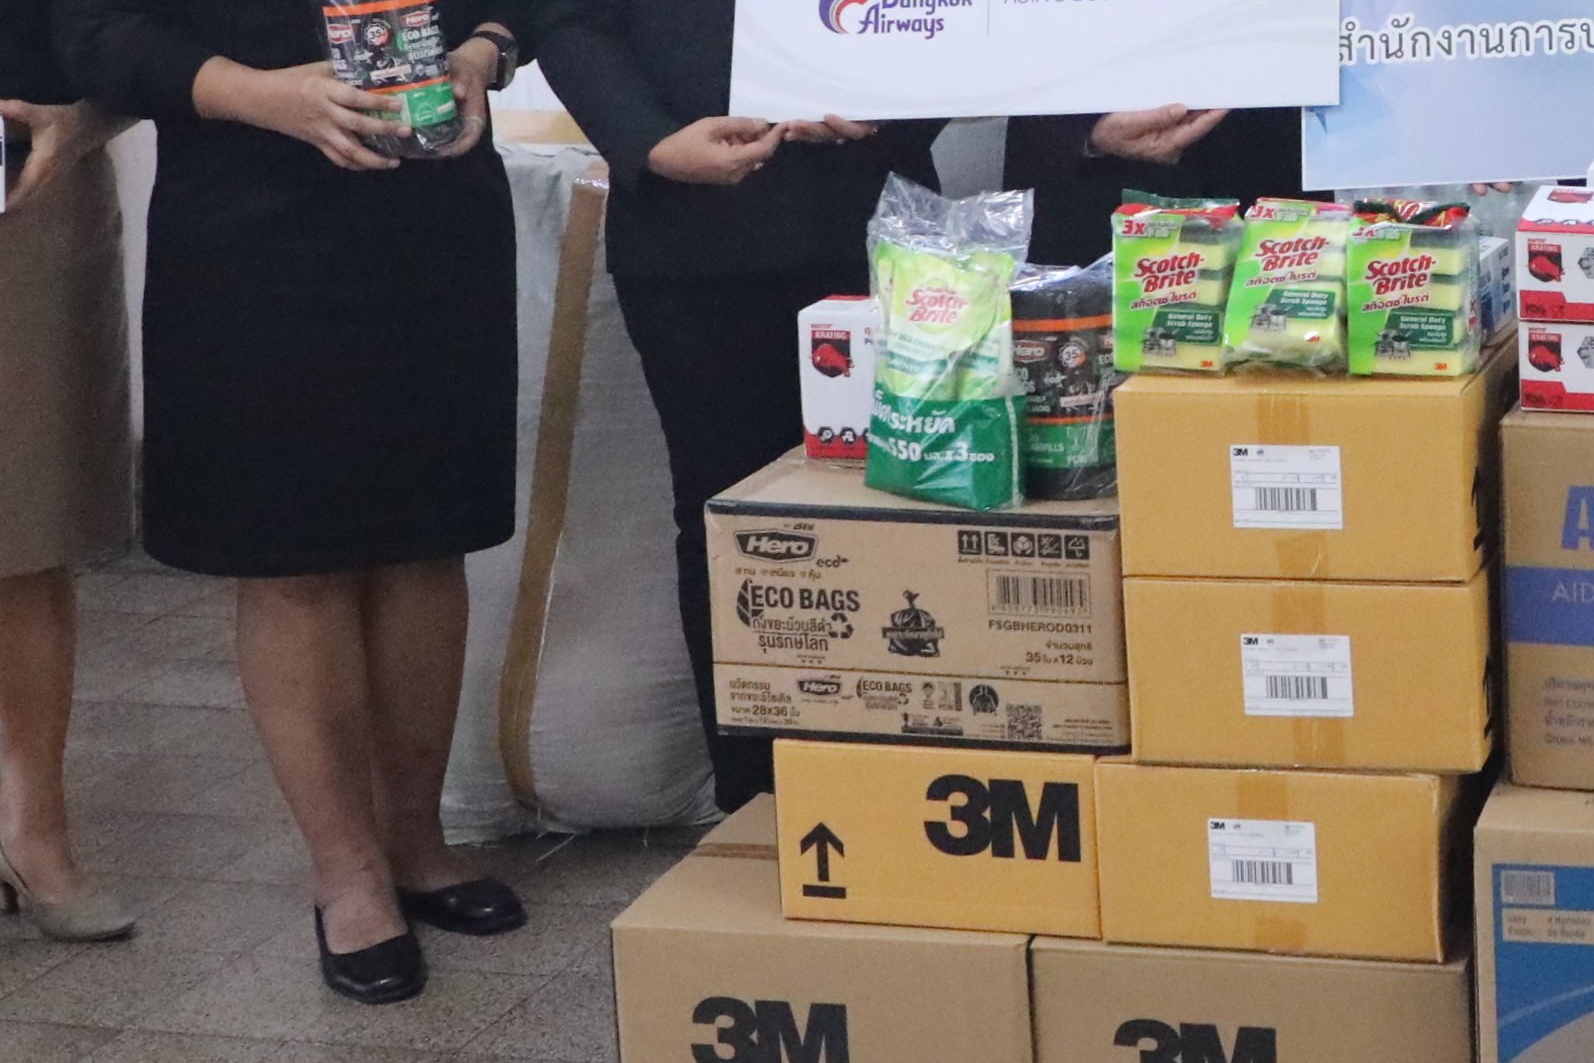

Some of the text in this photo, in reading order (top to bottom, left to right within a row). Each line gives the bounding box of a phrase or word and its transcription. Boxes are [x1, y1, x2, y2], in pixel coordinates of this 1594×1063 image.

[857, 4, 944, 39] Airways
[369, 30, 381, 38] 35
[1122, 220, 1145, 235] 3x
[1262, 252, 1318, 271] Brite
[1142, 270, 1195, 293] Brite
[1373, 272, 1427, 295] Brite
[908, 307, 958, 323] Brite
[1429, 316, 1446, 324] Duty
[1188, 321, 1212, 329] Sponge
[815, 331, 847, 339] KRATING
[1064, 351, 1079, 361] 35
[1233, 448, 1248, 456] 3M
[747, 536, 809, 555] Hero
[750, 585, 860, 612] ECO BAGS
[1243, 637, 1258, 645] 3M
[1026, 652, 1041, 663] 35
[1060, 655, 1073, 664] 12
[803, 682, 837, 692] Hero
[862, 681, 912, 693] ECO BAGS
[752, 705, 787, 716] 28x36
[924, 774, 1081, 863] 3M
[1211, 821, 1225, 830] 3M
[692, 996, 849, 1063] 3M
